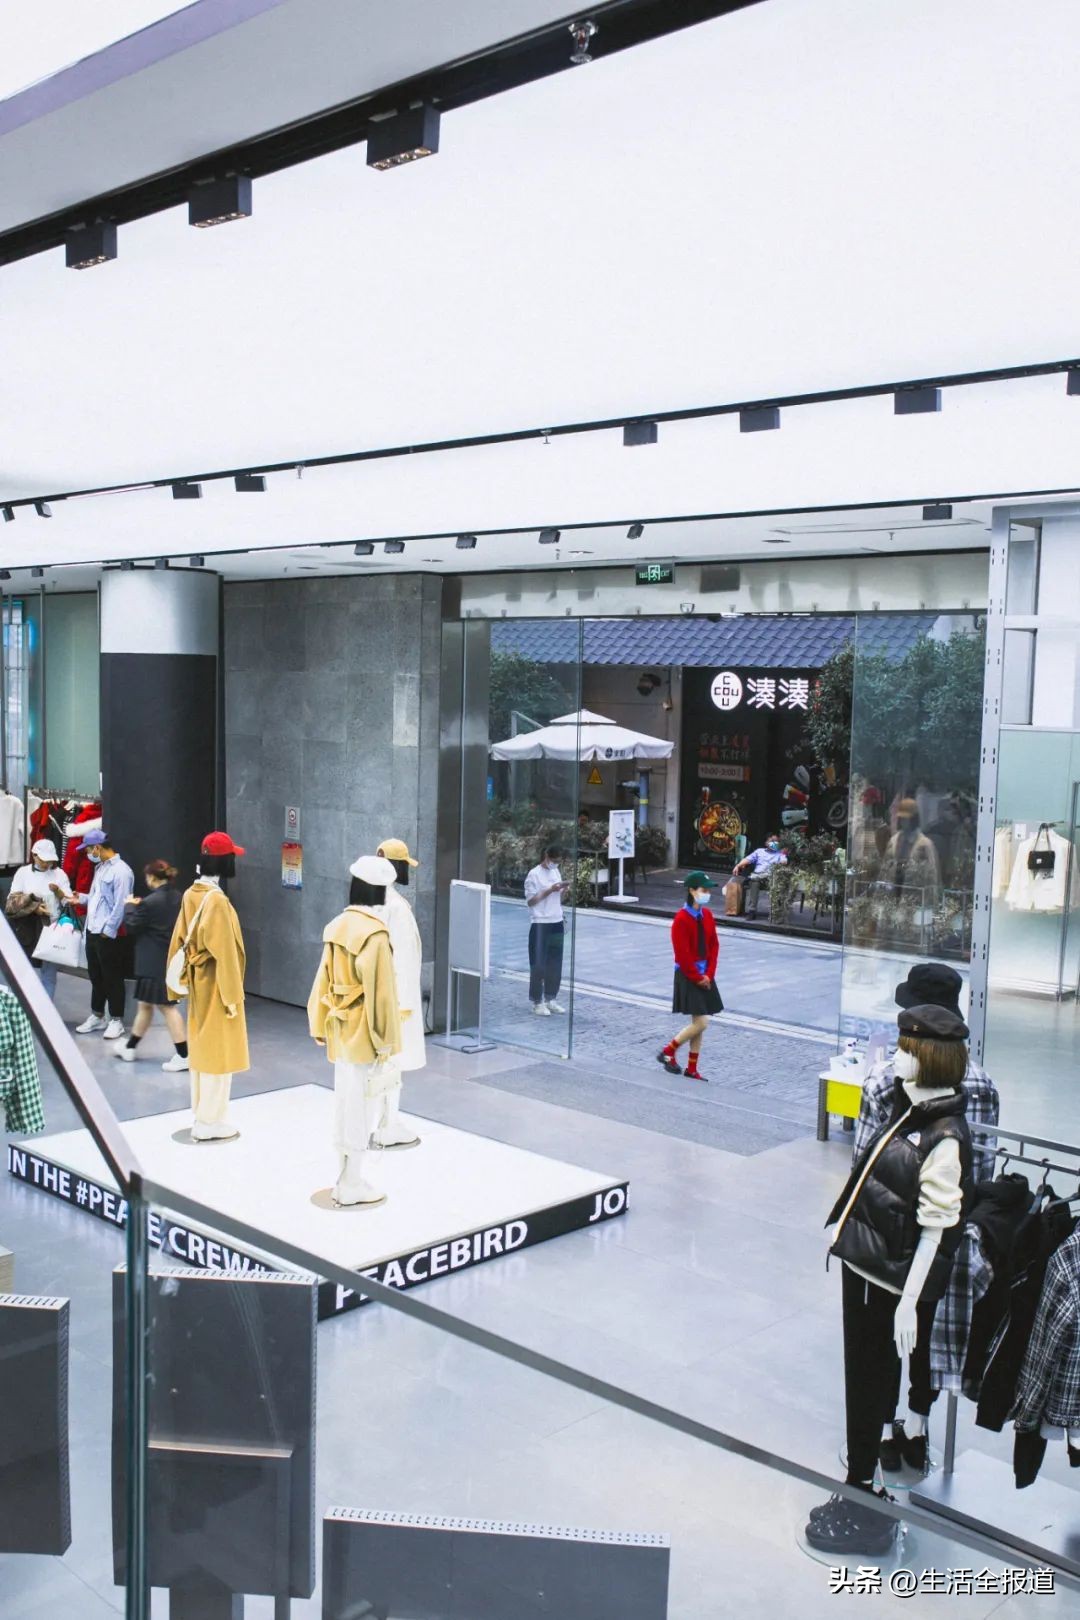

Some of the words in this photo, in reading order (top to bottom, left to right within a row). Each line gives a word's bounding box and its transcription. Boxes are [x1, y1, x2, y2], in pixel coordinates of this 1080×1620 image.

[8, 1147, 26, 1177] IN
[30, 1157, 71, 1199] THE
[76, 1180, 161, 1245] #PEAE
[168, 1226, 266, 1271] CREW
